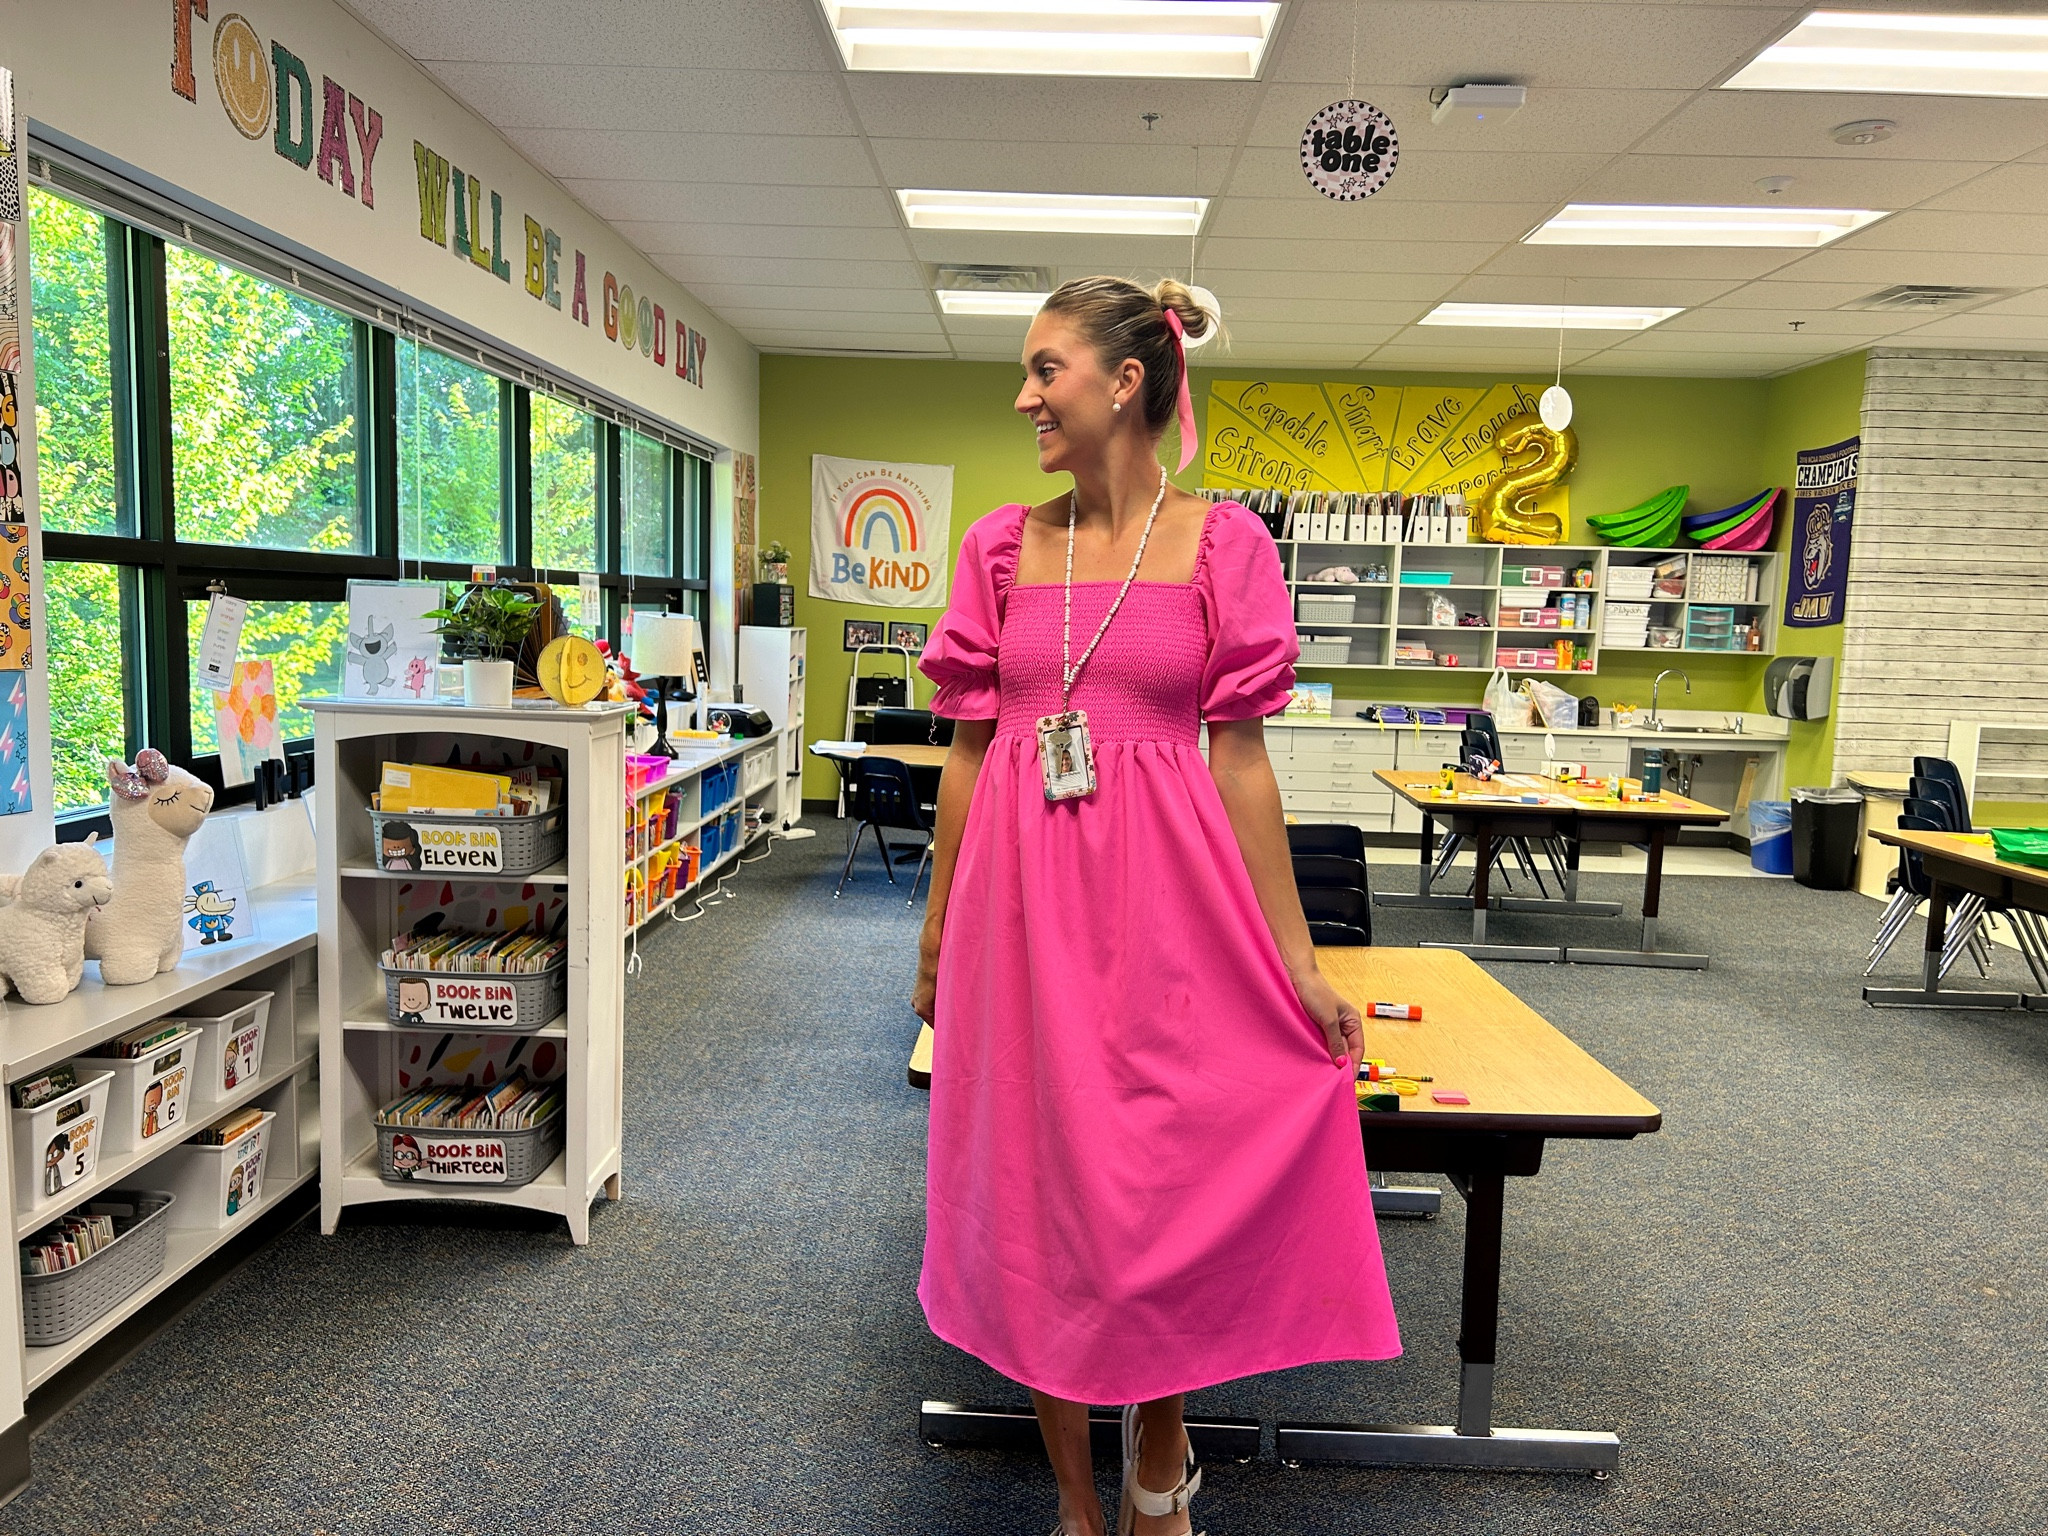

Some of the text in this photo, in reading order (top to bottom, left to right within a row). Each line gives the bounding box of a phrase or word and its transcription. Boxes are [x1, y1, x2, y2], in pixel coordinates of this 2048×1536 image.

[1311, 124, 1390, 157] table
[1321, 149, 1380, 173] one
[413, 139, 510, 284] WILL
[524, 213, 561, 311] BE
[572, 249, 589, 327] A
[603, 271, 666, 367] GOOD
[676, 319, 706, 389] DAY
[1239, 382, 1329, 458] Capable
[1339, 386, 1389, 463] Smart
[1391, 395, 1464, 471] Brave
[1210, 427, 1313, 491] Strong
[831, 468, 932, 511] IF YOU CAN BE ANYTHING
[831, 552, 866, 584] Be
[1792, 594, 1833, 620] JMU
[421, 830, 466, 847] BOOK
[437, 984, 481, 1000] BOOK
[163, 1070, 184, 1090] BOOK
[168, 1102, 176, 1120] 6
[69, 1119, 95, 1141] BOOK
[245, 1152, 261, 1171] BOOK
[427, 1144, 472, 1158] BOOK
[75, 1153, 85, 1175] 5
[248, 1181, 254, 1198] 9
